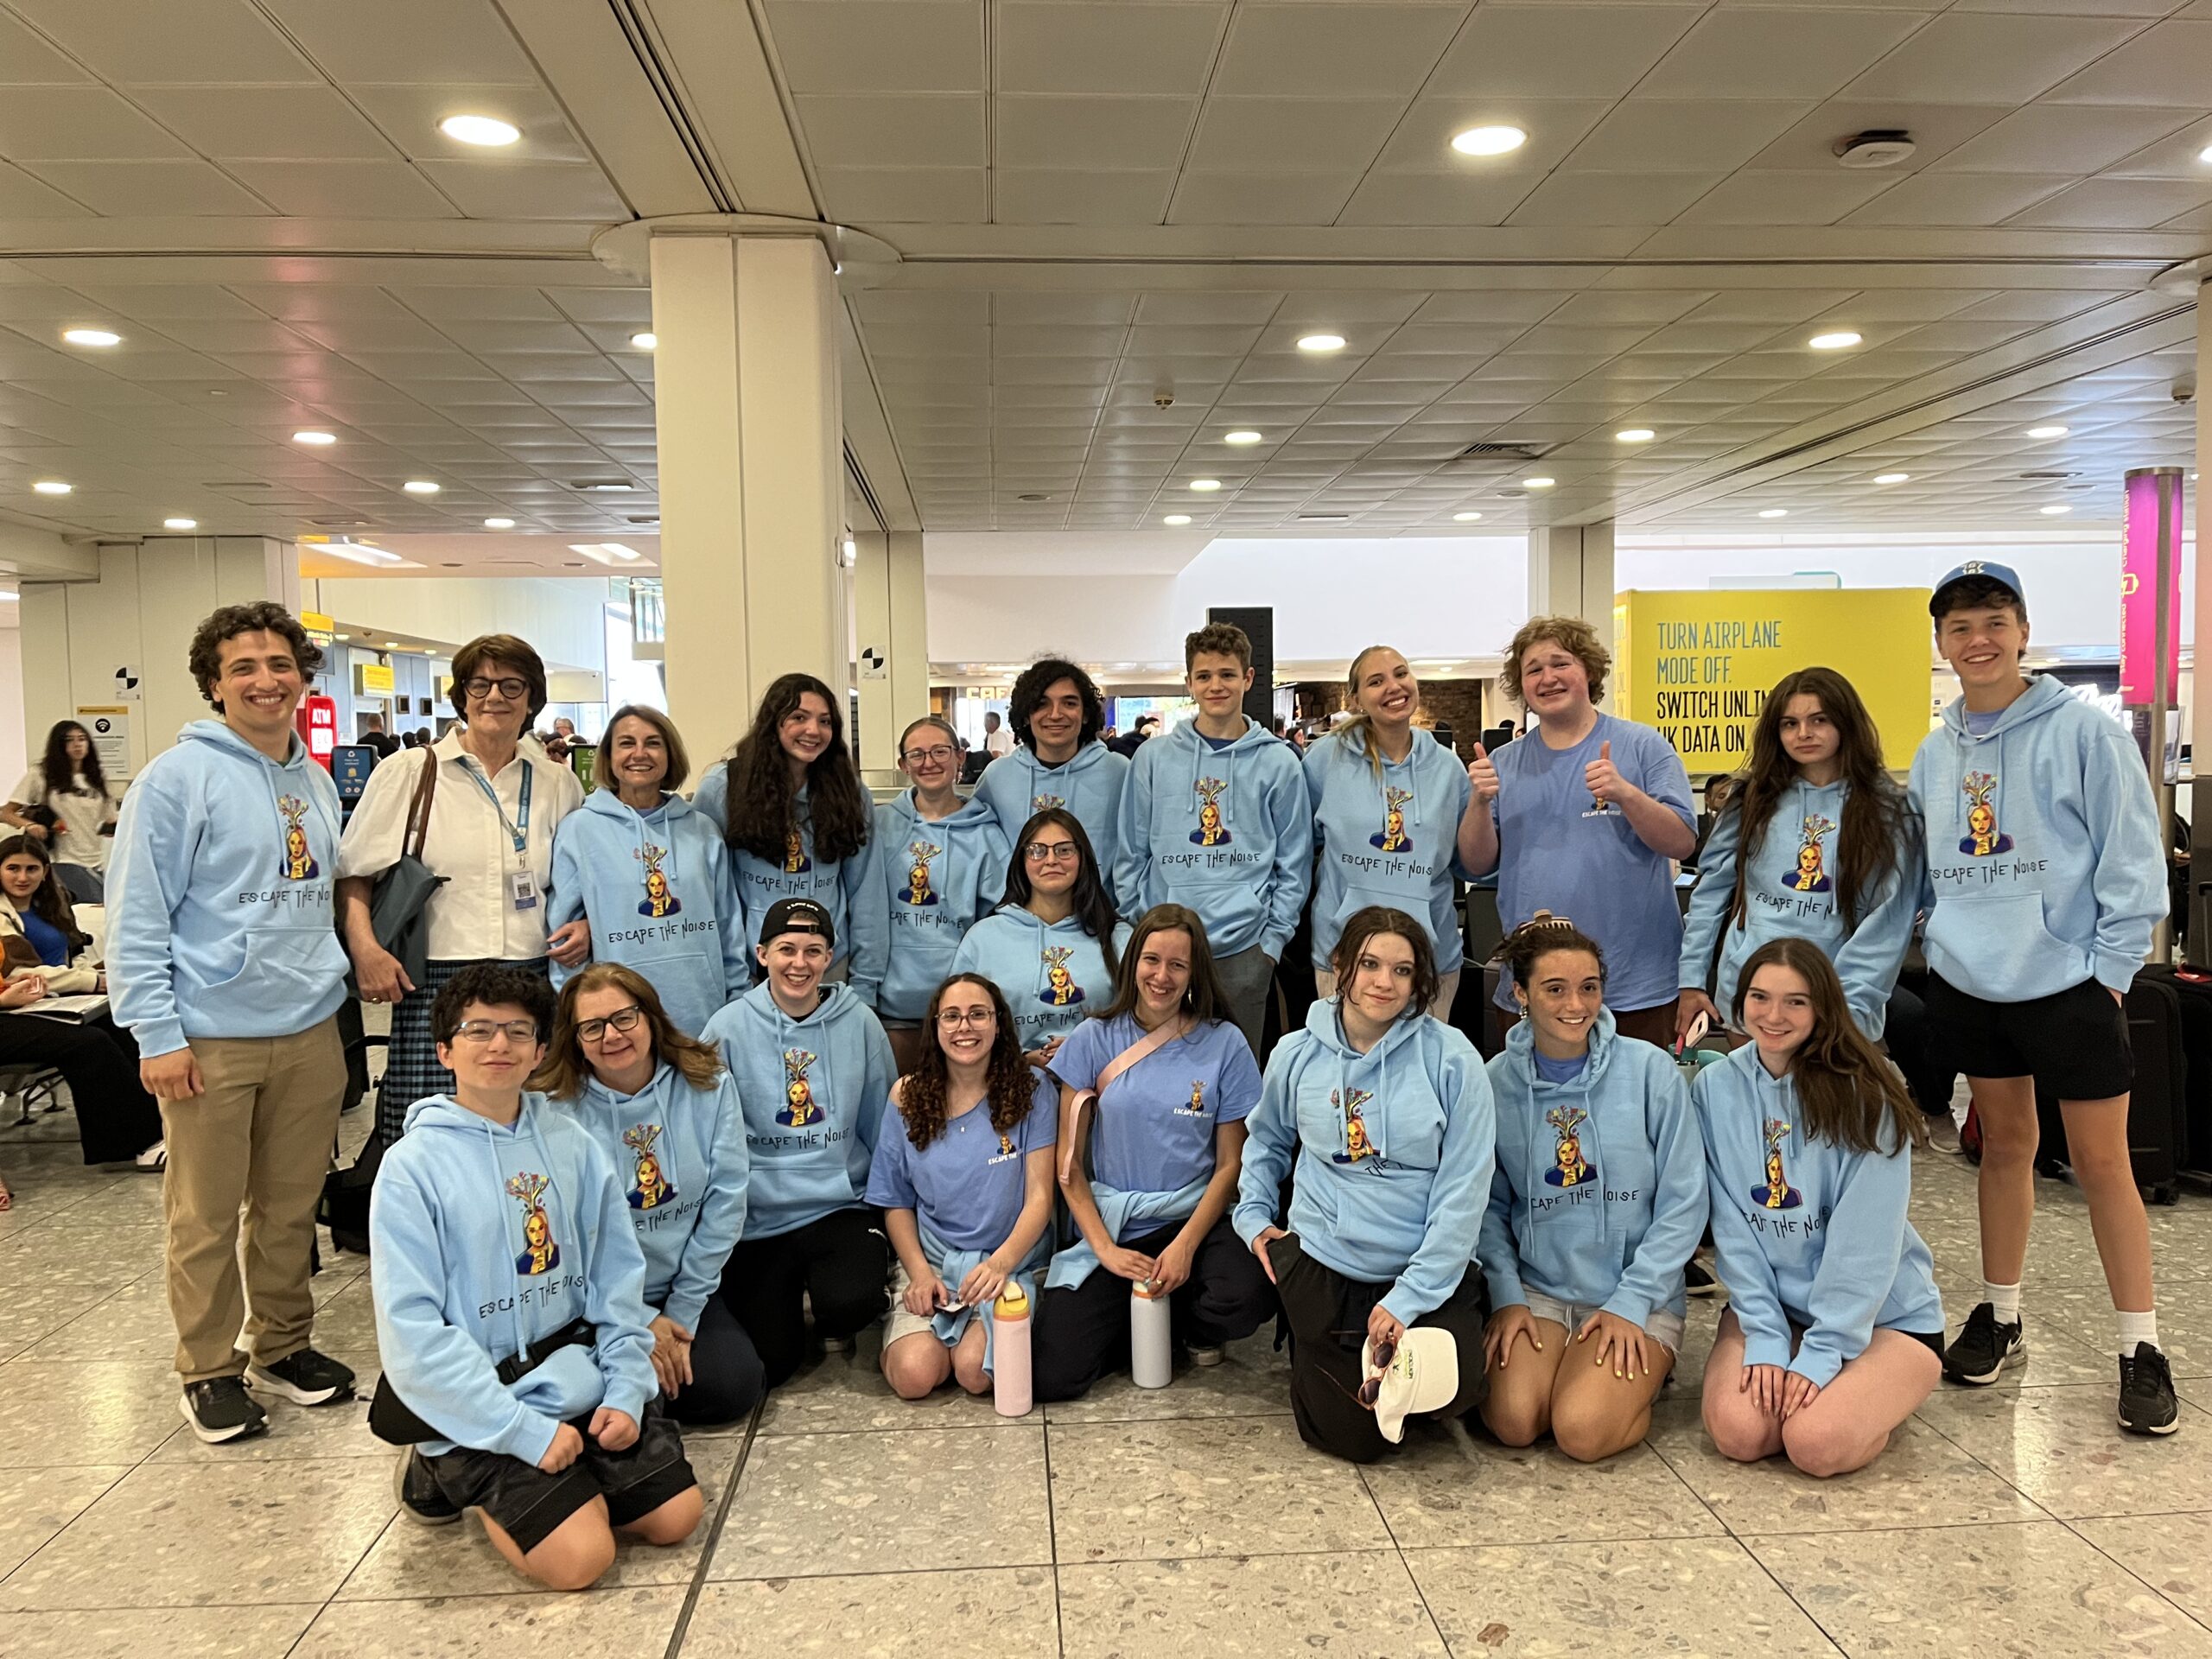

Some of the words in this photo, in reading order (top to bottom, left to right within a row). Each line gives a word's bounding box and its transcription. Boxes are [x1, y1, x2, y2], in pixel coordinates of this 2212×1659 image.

[1657, 622, 1697, 650] TURN
[1703, 620, 1782, 649] AIRPLANE
[1657, 657, 1698, 684] MODE
[1704, 656, 1732, 683] OFF.
[966, 687, 1009, 700] CAF
[1657, 691, 1718, 719] SWITCH
[312, 709, 331, 724] ATM
[1683, 725, 1720, 753] DATA
[1162, 854, 1202, 868] ESCAPE
[1206, 849, 1227, 868] THE
[1230, 849, 1261, 867] NOISE
[1342, 854, 1381, 872] ESCAPE
[1386, 856, 1406, 875] THE
[1408, 859, 1433, 879] NOIS
[1981, 859, 2008, 883] THE
[2014, 857, 2049, 880] NOISE
[238, 890, 290, 908] ESCAPE
[296, 885, 315, 908] THE
[318, 885, 330, 907] NO
[788, 876, 808, 894] THE
[1756, 892, 1793, 912] ESCAPE
[1797, 896, 1821, 917] THE
[915, 909, 932, 926] THE
[608, 927, 655, 944] ESCAPE
[659, 920, 678, 941] THE
[682, 918, 715, 938] NOISE
[1059, 1008, 1080, 1026] THE
[797, 1129, 819, 1149] THE
[988, 1154, 1007, 1165] ESCAPE
[1365, 1157, 1389, 1176] THE
[1530, 1195, 1563, 1211] CAPE
[1569, 1185, 1595, 1205] THE
[648, 1209, 671, 1232] THE
[675, 1198, 702, 1221] NOIS
[1772, 1214, 1797, 1239] THE
[538, 1276, 560, 1307] THE
